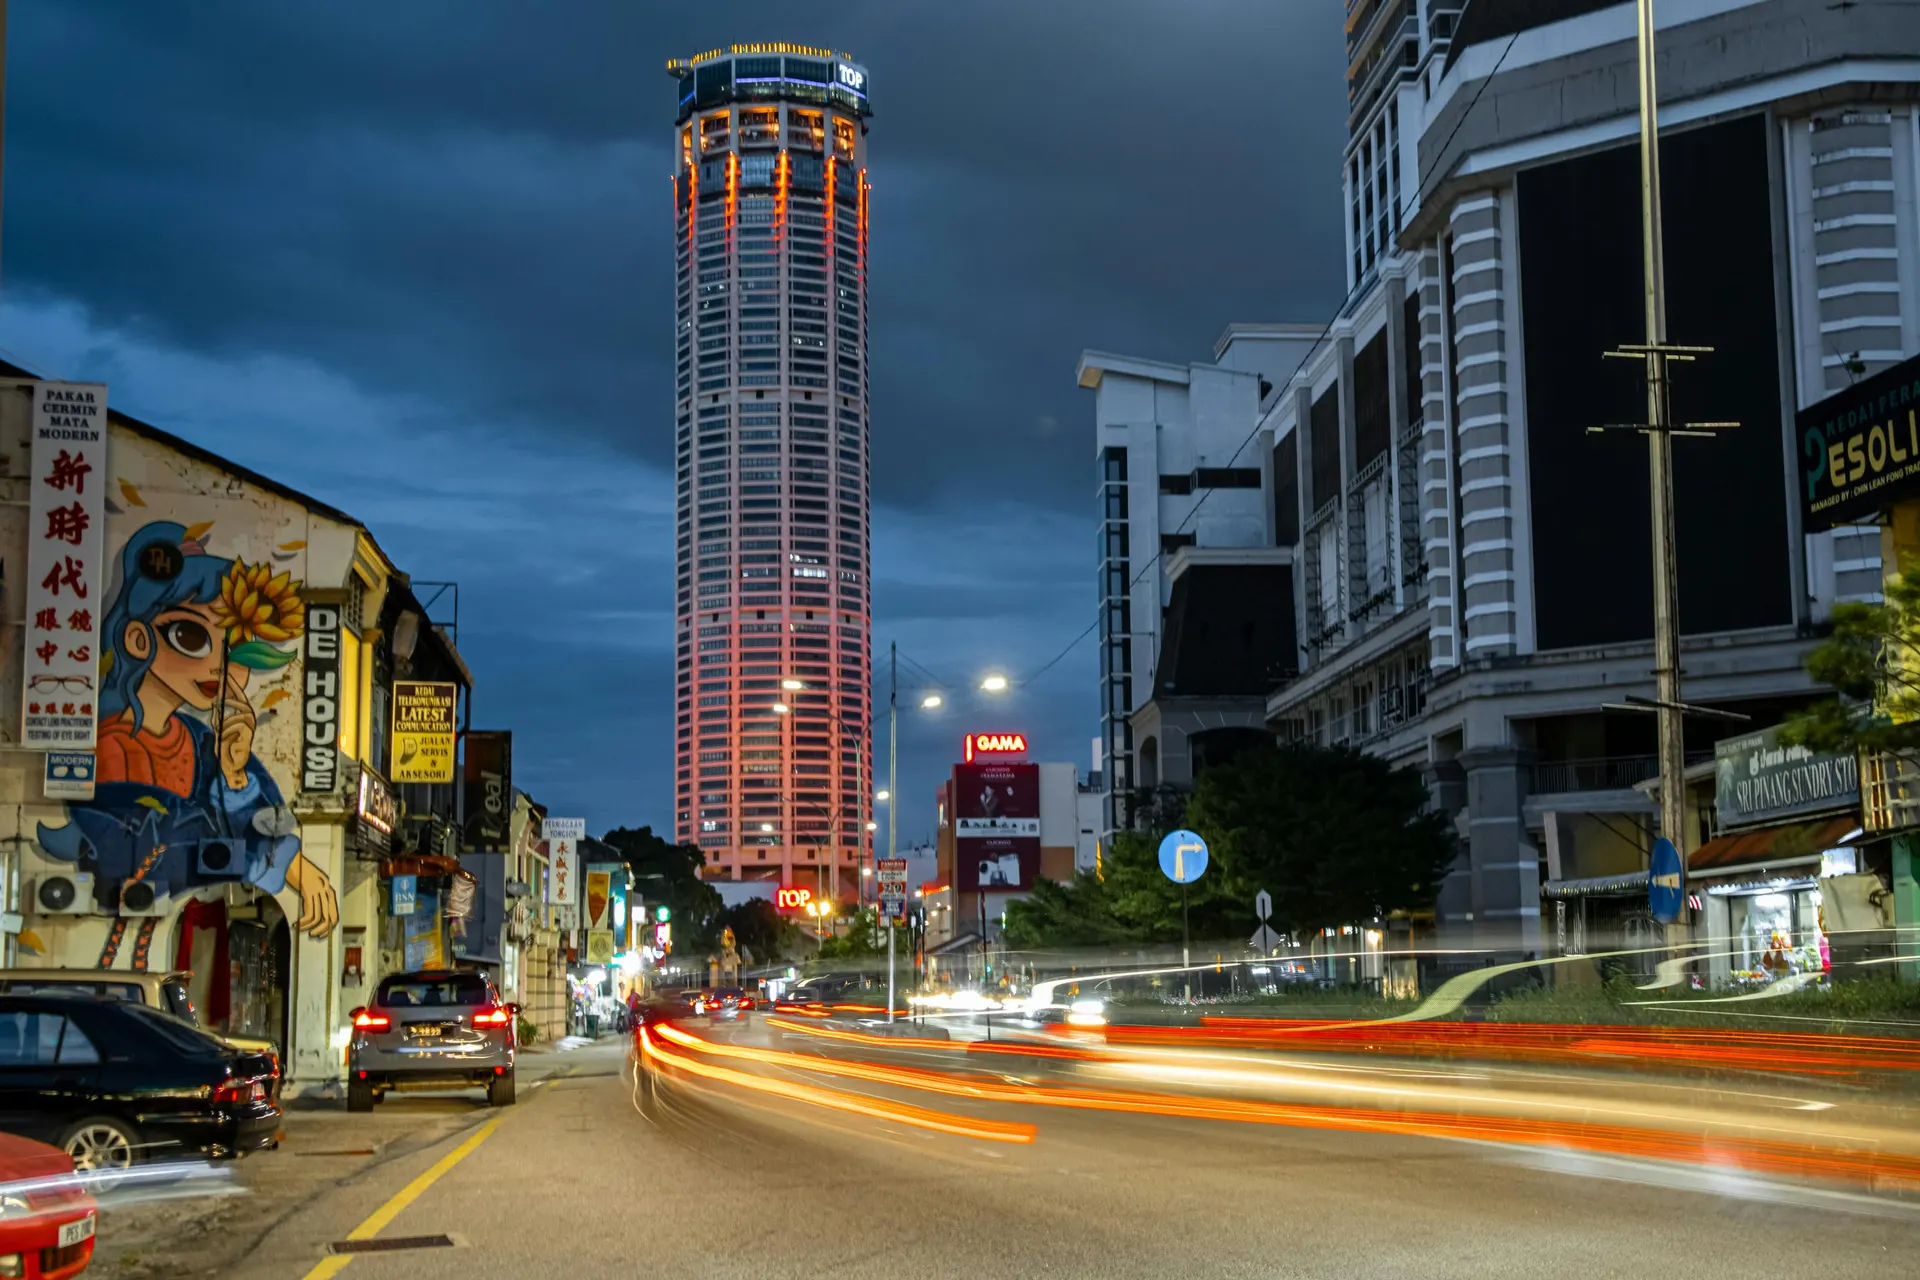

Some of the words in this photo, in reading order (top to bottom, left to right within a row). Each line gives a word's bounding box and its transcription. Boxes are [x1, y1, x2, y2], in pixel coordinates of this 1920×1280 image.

[839, 64, 863, 89] TOP
[46, 390, 95, 403] PAKAR
[43, 403, 97, 416] CERMIN
[50, 416, 90, 428] MATA
[1826, 404, 1873, 437] KEDAI
[39, 429, 99, 441] MODERN
[1805, 409, 1919, 500] PESOLI
[1810, 493, 1840, 513] MANAGED
[1853, 482, 1869, 497] CHIN
[1869, 474, 1885, 490] LEAN
[1886, 467, 1904, 484] FONG
[42, 449, 92, 599] 新時代
[308, 609, 337, 659] DE
[414, 686, 435, 697] KEDAI
[398, 696, 452, 707] TELEKOMUNIKASI
[401, 707, 447, 722] LATEST
[305, 671, 335, 789] HOUSE
[396, 721, 451, 732] COMMUNICATION
[28, 730, 51, 740] TESTING
[52, 730, 60, 740] OF
[61, 730, 73, 740] EYE
[420, 737, 451, 746] JUALAN
[976, 734, 1026, 751] GAMA
[421, 748, 448, 757] SERVIS
[50, 755, 92, 766] MODERN
[400, 770, 446, 779] AKSESORI
[1736, 777, 1752, 813] SRI
[1754, 770, 1791, 810] PINANG
[1792, 761, 1834, 802] SUNDRY
[1835, 755, 1857, 793] STO
[545, 821, 582, 829] PERNIAGAAN
[779, 889, 811, 907] TOP
